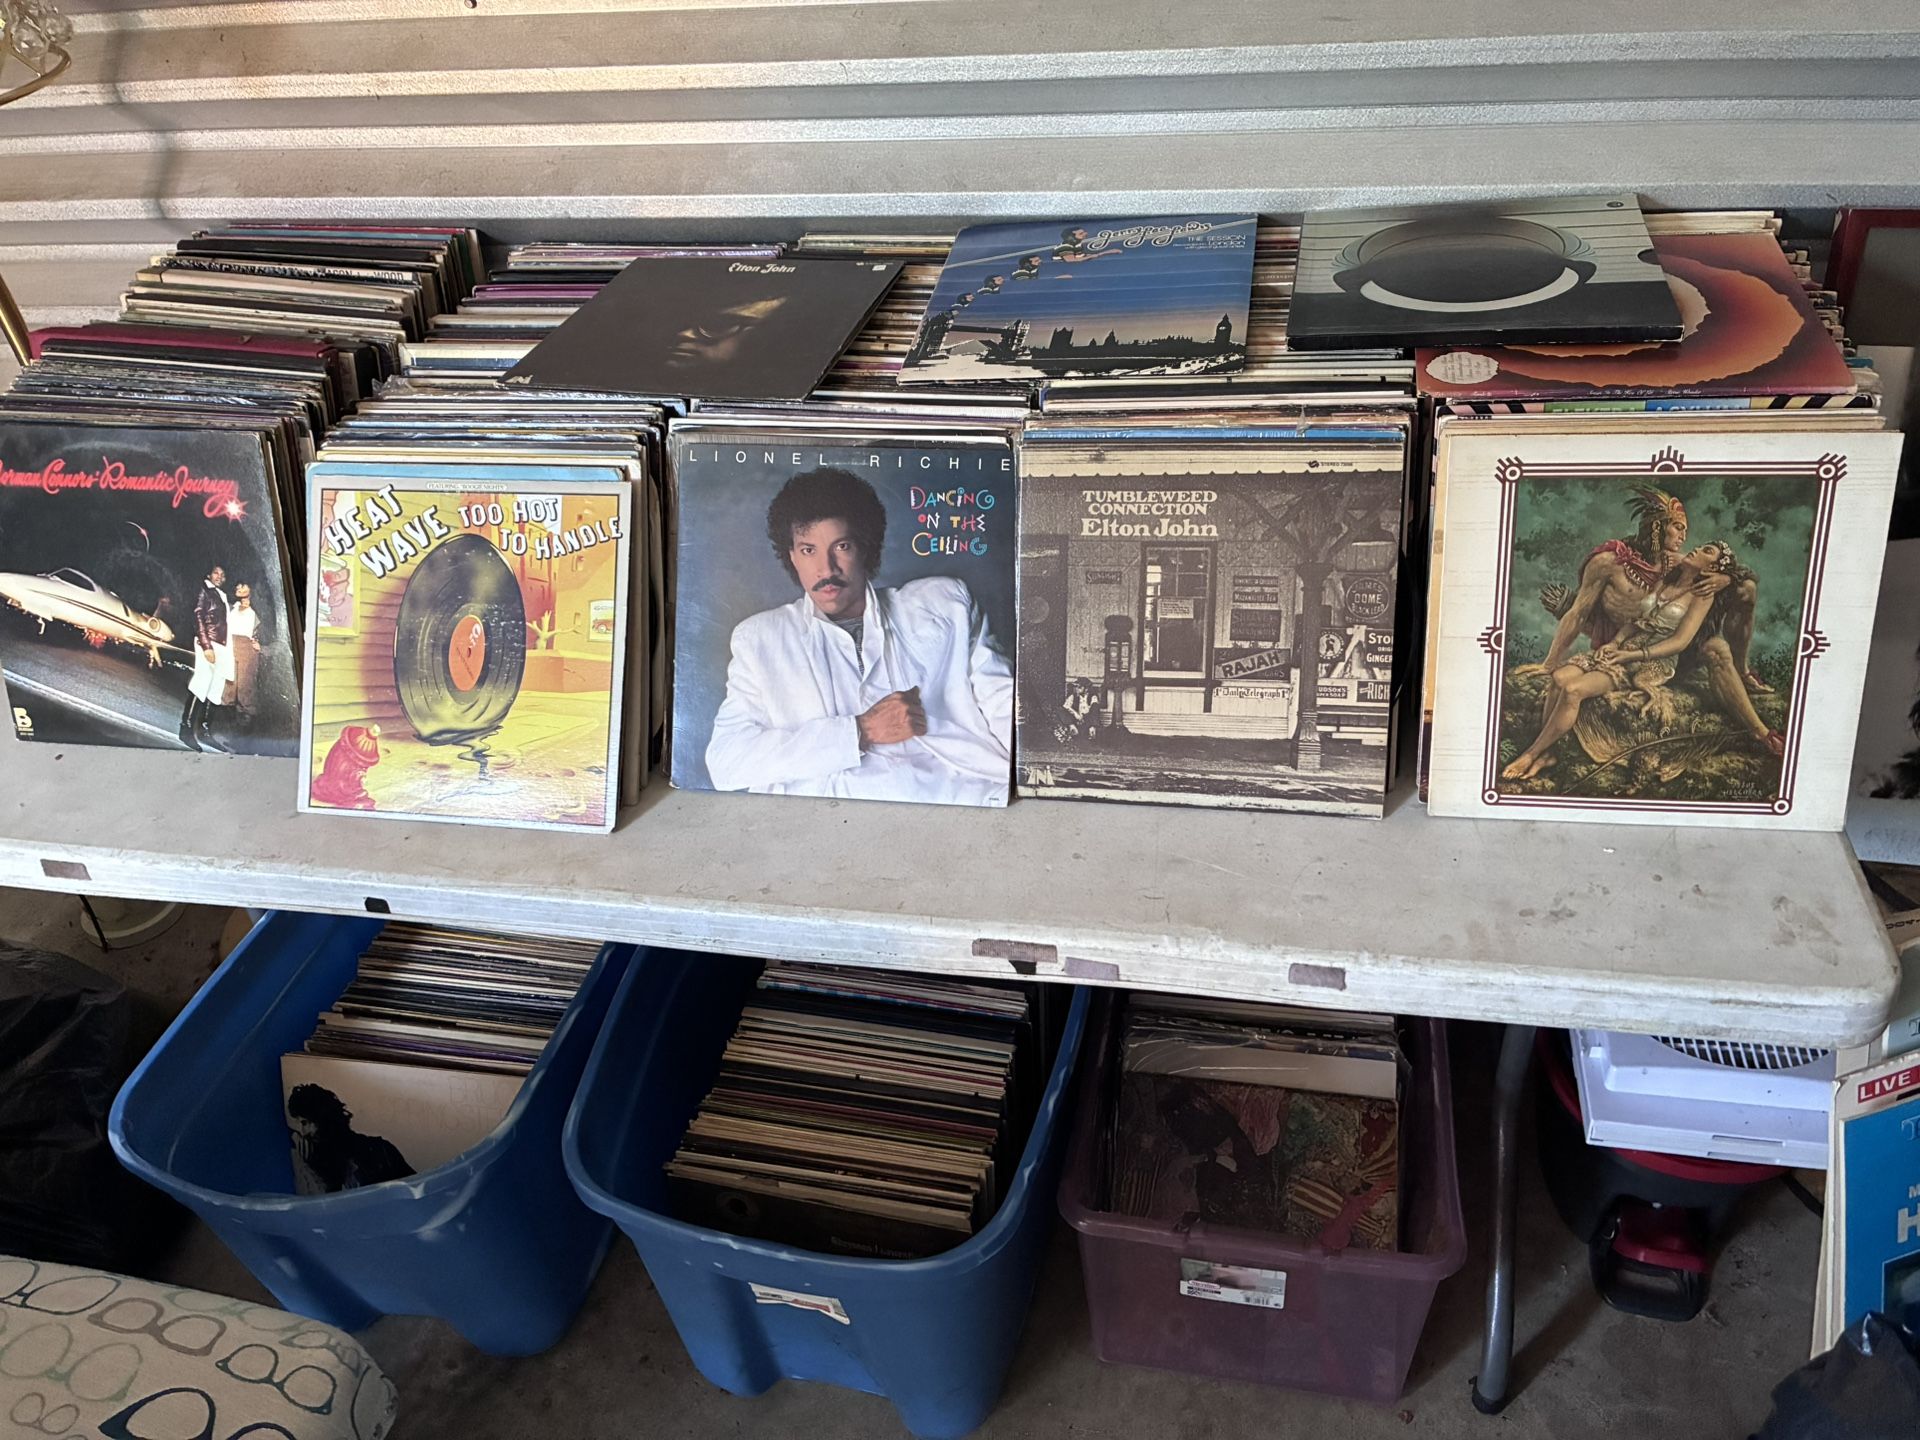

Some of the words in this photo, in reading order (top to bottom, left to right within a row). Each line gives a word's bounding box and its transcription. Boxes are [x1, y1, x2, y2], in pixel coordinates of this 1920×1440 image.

[728, 262, 760, 273] Elton
[761, 263, 796, 274] John
[689, 451, 828, 467] LIONEL
[869, 454, 1012, 472] RICHIE
[0, 459, 42, 488] orman
[99, 455, 176, 491] Romantic
[171, 465, 239, 518] Journey
[1083, 490, 1218, 503] TUMBLEWEED
[324, 484, 403, 556] HEAT
[458, 502, 503, 528] TOO
[512, 498, 560, 524] HOT
[1088, 503, 1208, 515] CONNECTION
[917, 513, 940, 529] ON
[949, 514, 986, 532] THE
[1081, 518, 1151, 537] Elton
[1153, 518, 1219, 537] John
[360, 506, 450, 580] WAVE
[500, 527, 528, 556] TO
[534, 516, 624, 561] HANDLE
[1368, 632, 1393, 645] STO
[1221, 651, 1281, 678] RAJAH
[1859, 1071, 1911, 1100] LIVE
